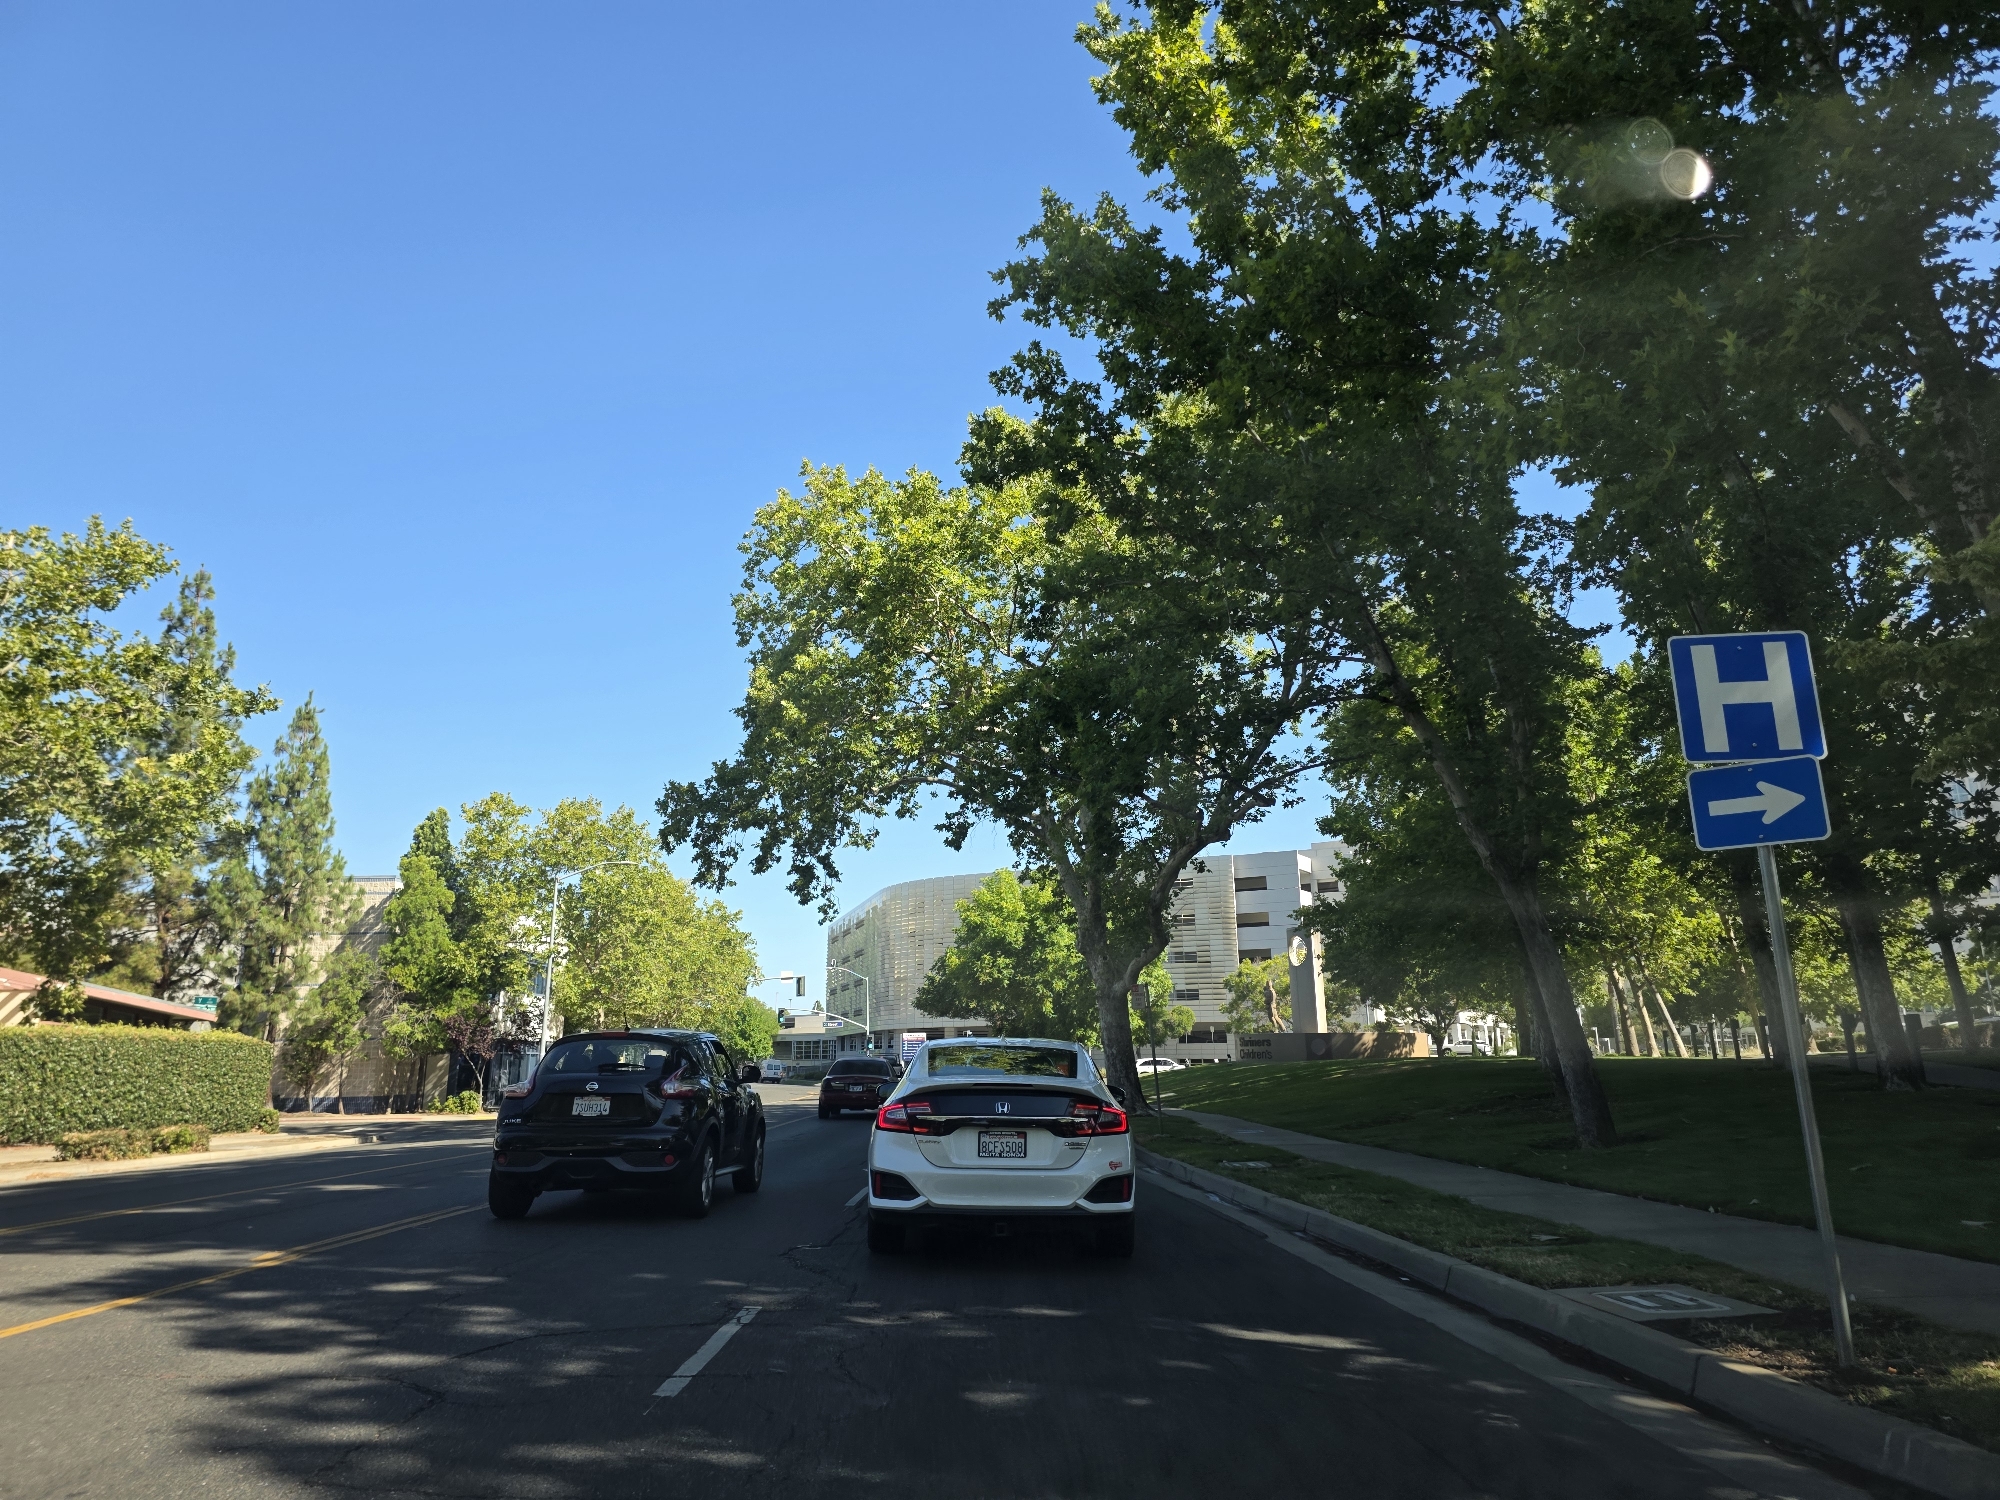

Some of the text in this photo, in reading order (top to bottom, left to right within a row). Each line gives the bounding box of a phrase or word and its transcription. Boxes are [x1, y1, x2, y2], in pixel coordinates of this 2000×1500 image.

[1690, 641, 1803, 752] H
[1239, 1037, 1271, 1047] Shriners
[1240, 1049, 1272, 1059] Children's
[981, 1141, 1023, 1153] 8CFS508
